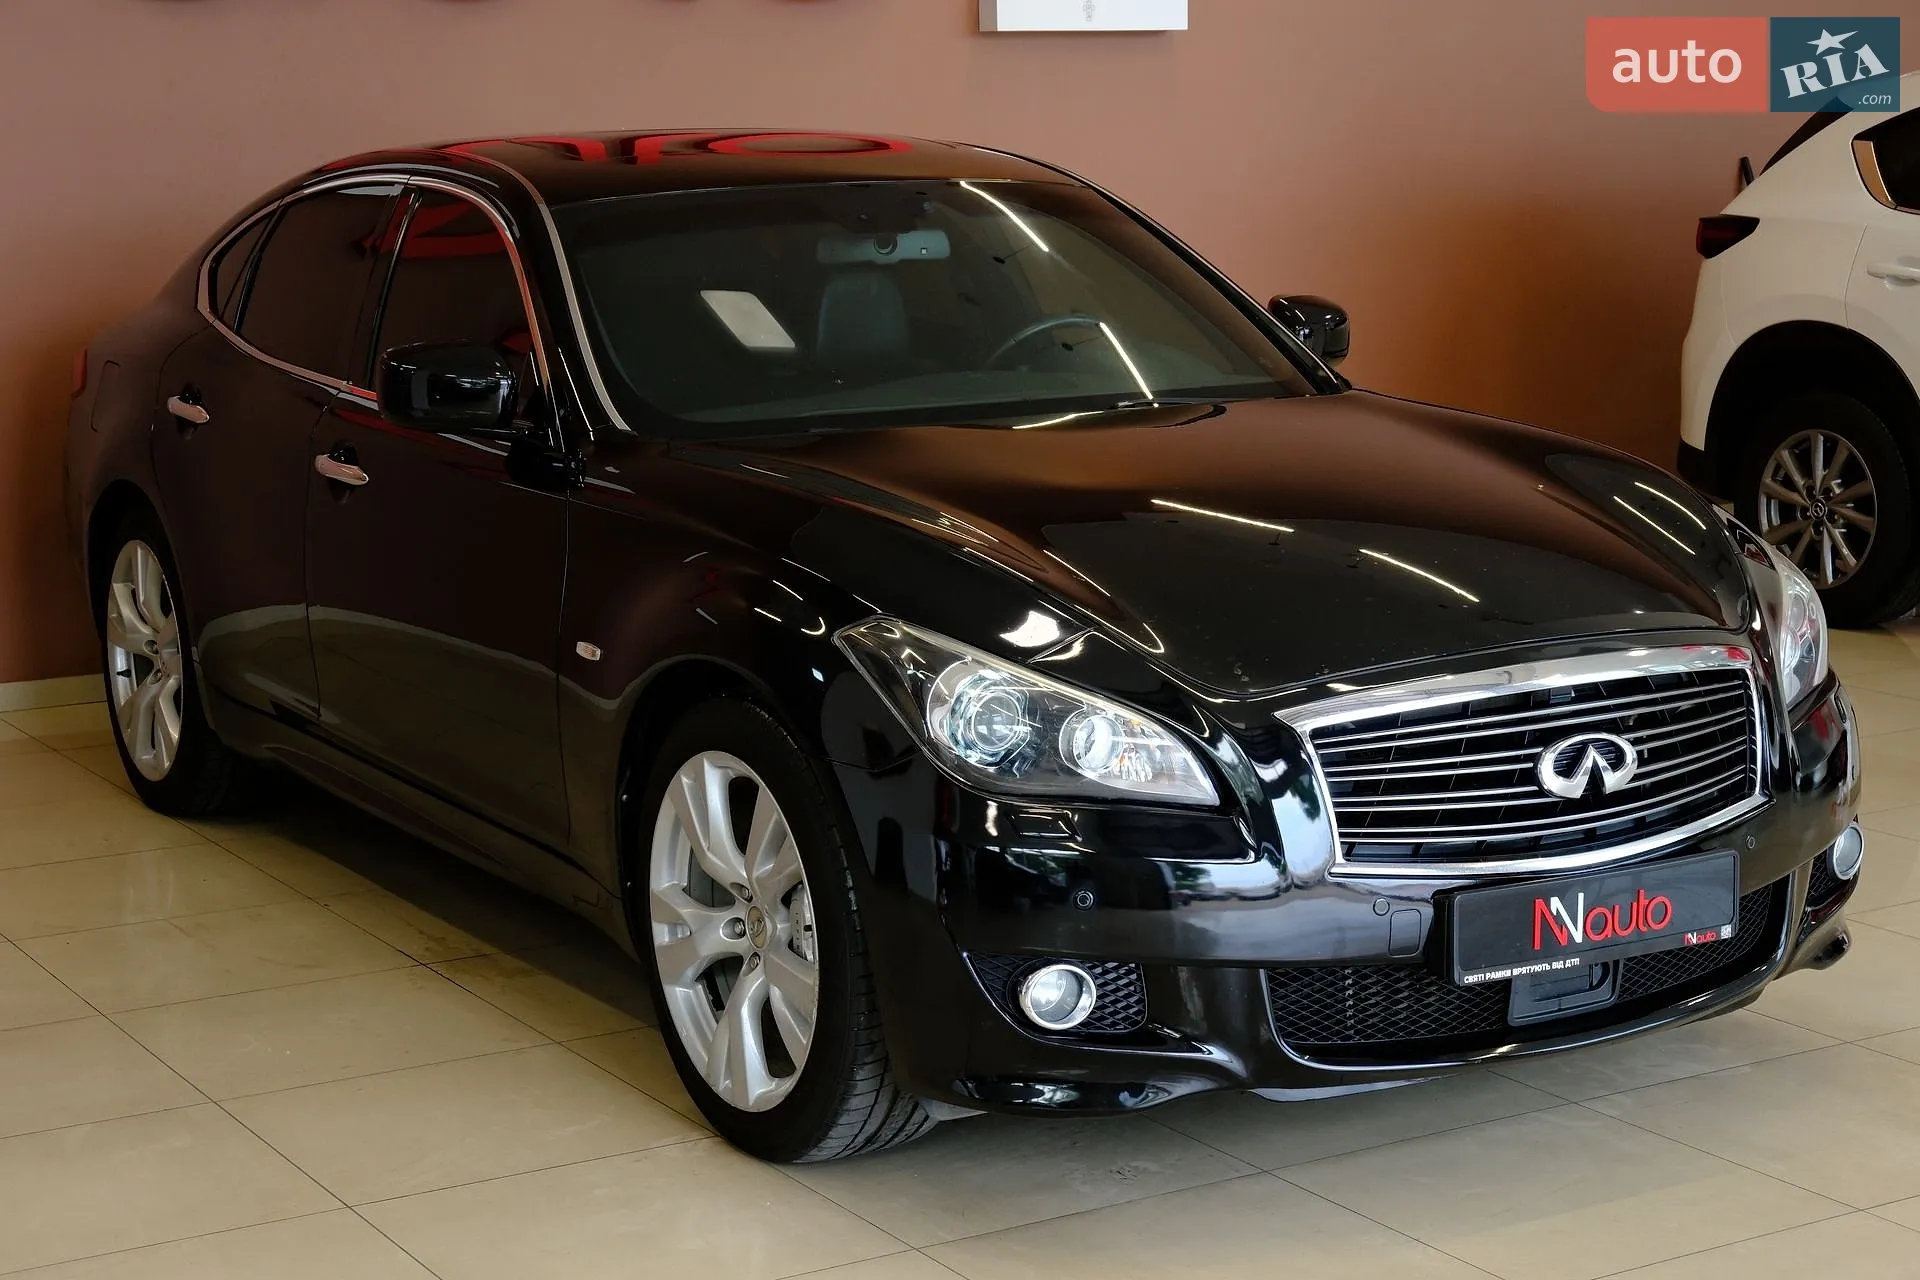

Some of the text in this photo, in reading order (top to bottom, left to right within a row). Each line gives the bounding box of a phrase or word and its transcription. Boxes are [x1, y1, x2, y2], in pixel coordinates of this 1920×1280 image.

[1485, 969, 1512, 980] РАМКИ
[1552, 960, 1564, 970] ВІД
[1565, 957, 1580, 969] ДТП
